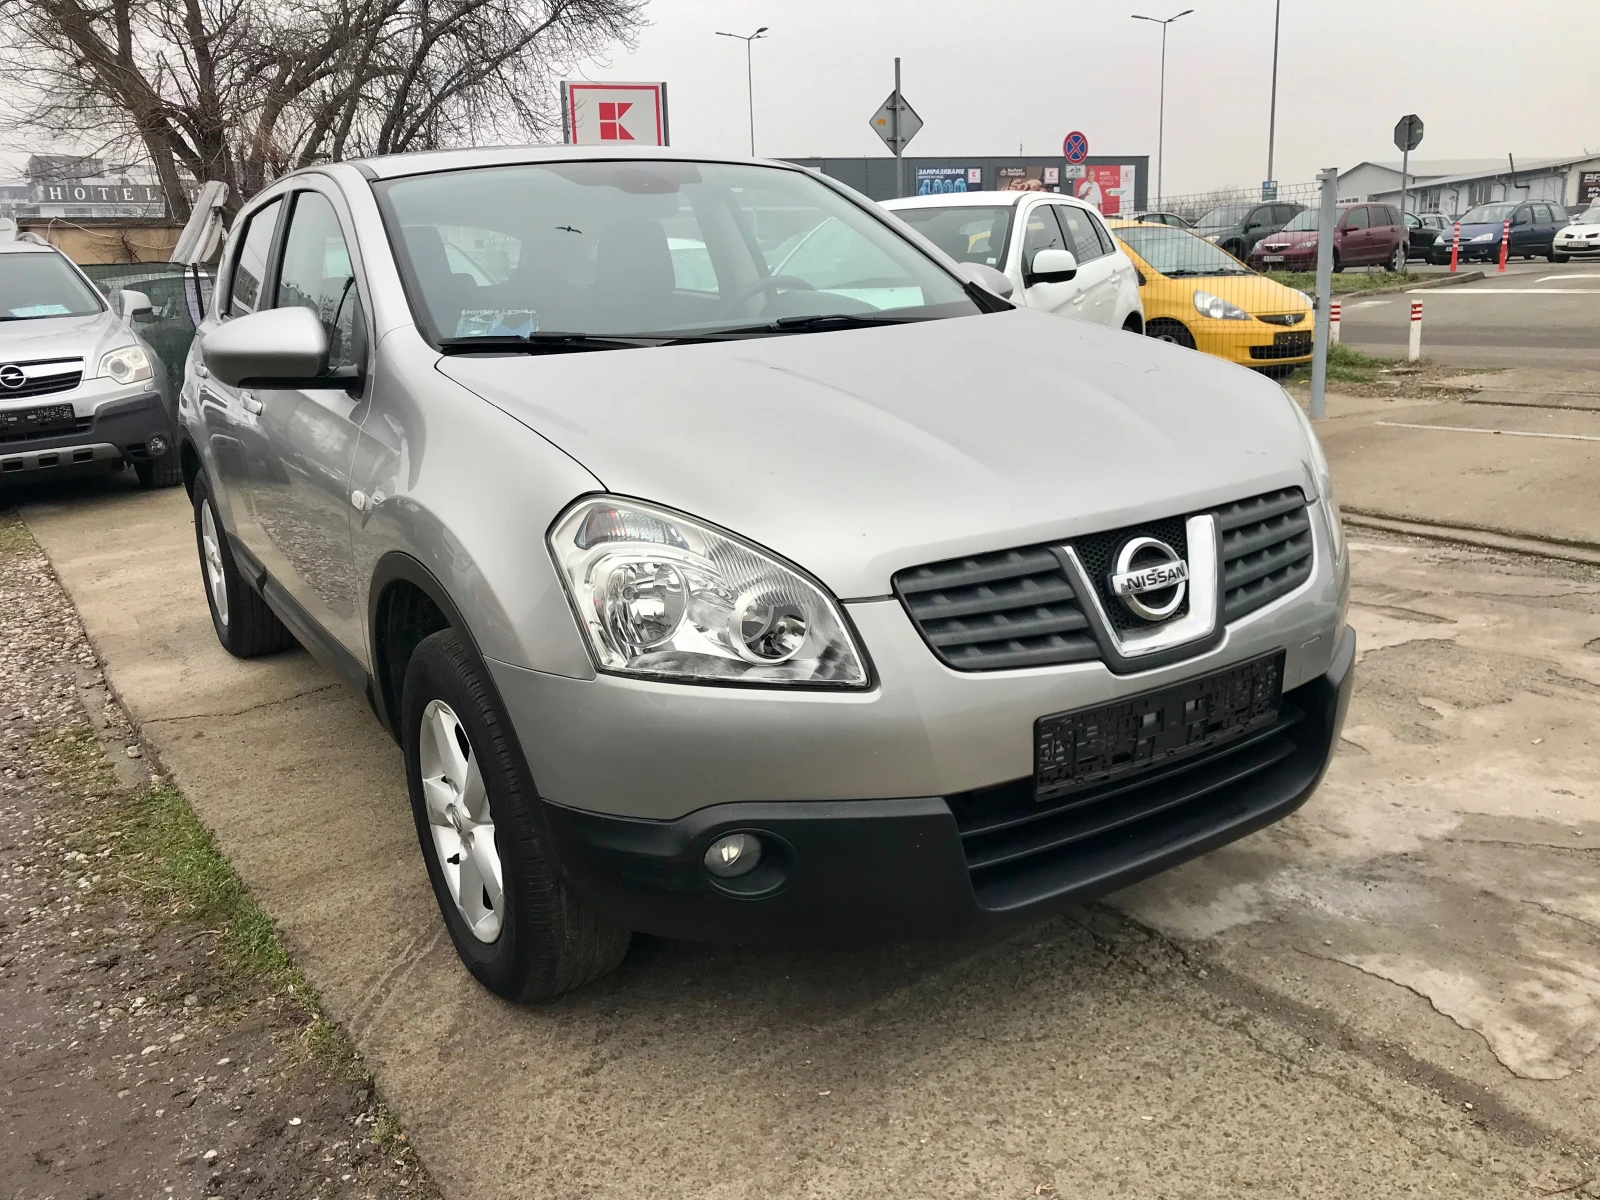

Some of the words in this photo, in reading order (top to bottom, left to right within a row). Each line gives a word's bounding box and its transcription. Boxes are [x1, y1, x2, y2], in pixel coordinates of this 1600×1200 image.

[598, 102, 636, 141] K
[49, 187, 157, 201] HOTEL
[1126, 565, 1186, 590] NISSAN
